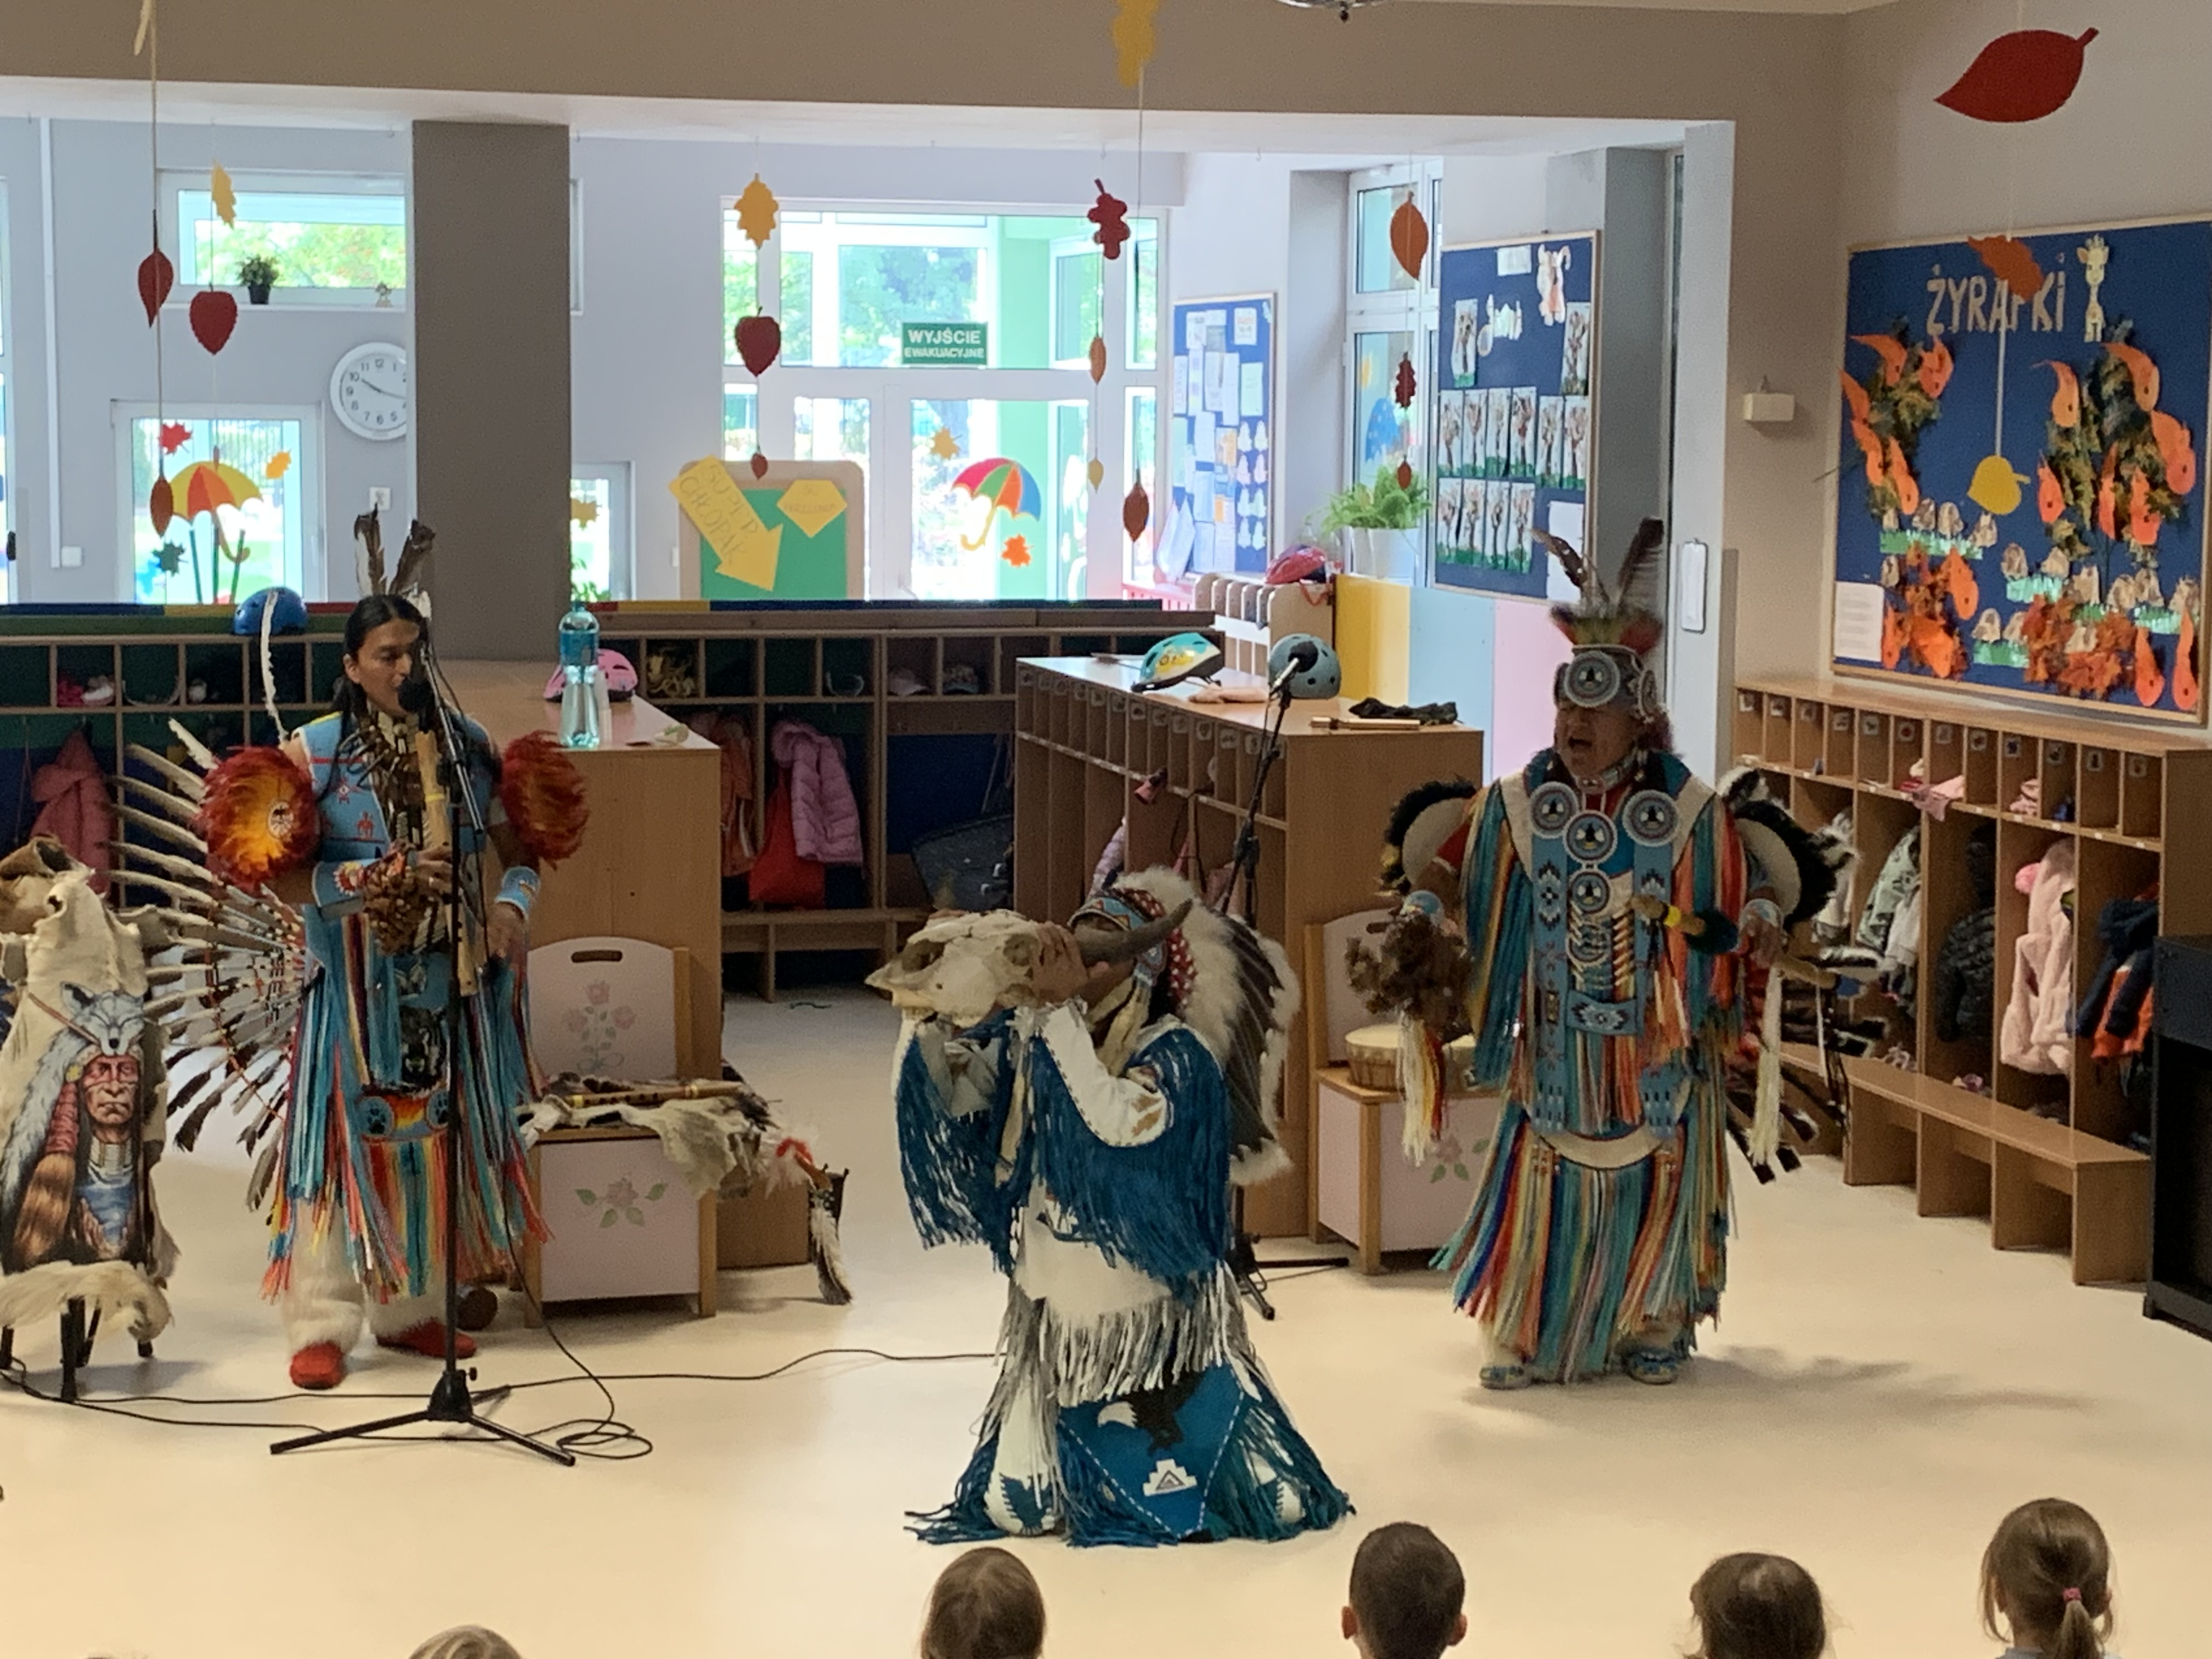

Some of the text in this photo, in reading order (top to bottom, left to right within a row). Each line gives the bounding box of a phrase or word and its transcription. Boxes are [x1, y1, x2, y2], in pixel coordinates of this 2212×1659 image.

[909, 328, 980, 344] WYJŚCIE
[905, 348, 984, 358] EWAKUACYJNE
[361, 362, 370, 371] 11
[375, 358, 384, 368] 12
[349, 371, 360, 382] 10
[346, 386, 354, 396] 9
[364, 411, 370, 421] 7
[376, 414, 384, 425] 6
[390, 411, 398, 421] 5
